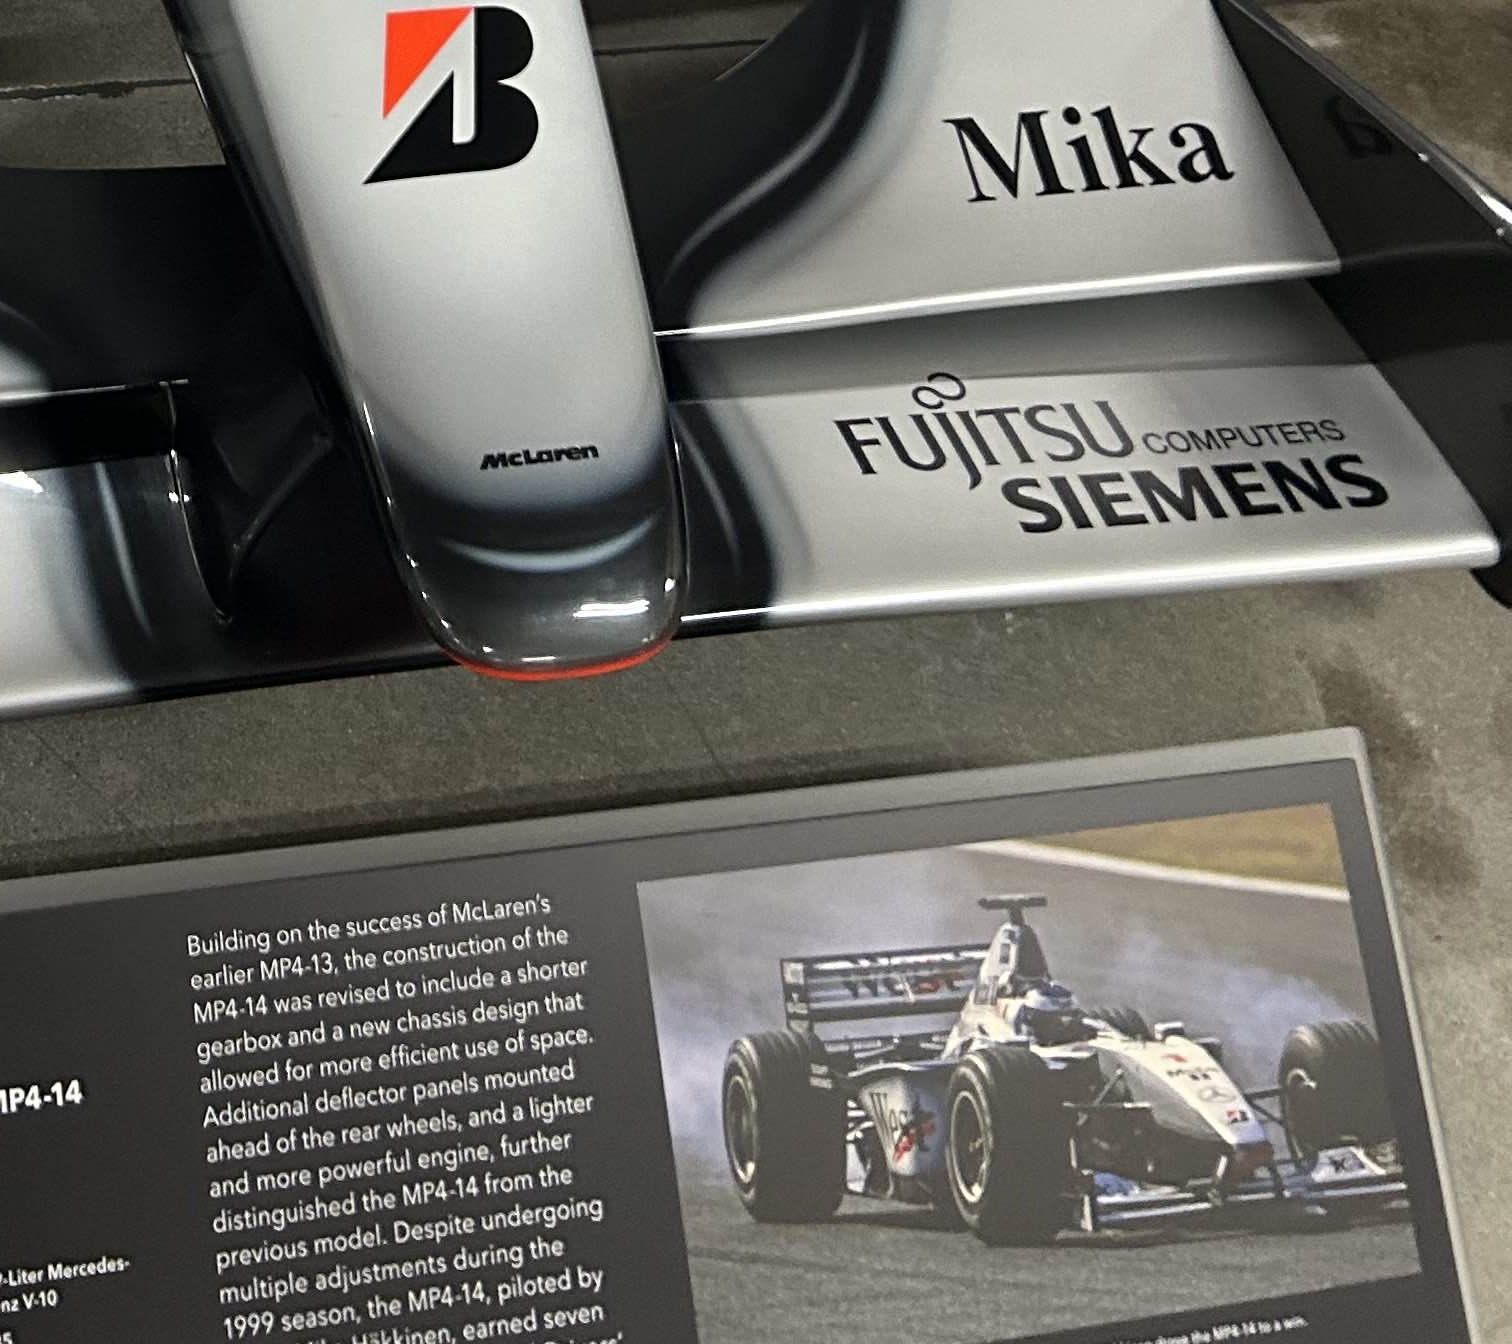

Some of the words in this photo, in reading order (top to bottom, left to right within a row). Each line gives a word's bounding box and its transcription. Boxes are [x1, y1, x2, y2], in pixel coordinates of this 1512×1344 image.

[942, 106, 1235, 202] Mika
[479, 444, 599, 471] McLaren
[833, 372, 1135, 490] FUJITSU
[1141, 419, 1347, 456] COMPUTERS
[1000, 454, 1390, 535] SIEMENS
[188, 929, 270, 956] Building
[277, 929, 302, 945] on
[308, 919, 340, 941] the
[346, 914, 422, 937] success
[428, 903, 447, 927] of
[452, 893, 551, 924] McLaren's
[191, 964, 254, 990] earlier
[260, 952, 338, 981] MP4-13,
[344, 948, 377, 970] the
[383, 934, 506, 966] construction
[512, 926, 532, 951] of
[536, 925, 568, 947] the
[194, 995, 268, 1024] MP4-14
[274, 995, 312, 1014] was
[318, 978, 390, 1007] revised
[395, 980, 416, 999] to
[422, 966, 495, 994] include
[501, 970, 512, 986] a
[517, 960, 588, 984] shorter
[197, 1030, 282, 1064] gearbox
[288, 1020, 326, 1047] and
[333, 1025, 343, 1041] a
[350, 1020, 390, 1038] new
[397, 1005, 467, 1033] chassis
[473, 998, 539, 1024] design
[544, 991, 584, 1014] that
[201, 1061, 279, 1093] allowed
[285, 1059, 313, 1081] for
[320, 1056, 372, 1077] more
[379, 1042, 460, 1070] efficient
[465, 1040, 499, 1059] use
[505, 1029, 524, 1053] of
[530, 1029, 593, 1056] space.
[203, 1092, 308, 1128] Additional
[316, 1086, 406, 1113] deflector
[413, 1072, 479, 1106] panels
[485, 1057, 575, 1090] mounted
[207, 1132, 270, 1163] ahead
[277, 1128, 297, 1153] of
[302, 1126, 335, 1149] the
[342, 1125, 380, 1144] rear
[387, 1108, 462, 1138] wheels,
[469, 1100, 506, 1127] and
[513, 1106, 524, 1121] a
[529, 1094, 593, 1124] lighter
[210, 1171, 249, 1197] and
[257, 1170, 311, 1191] more
[319, 1148, 411, 1188] powerful
[418, 1143, 494, 1171] engine,
[500, 1131, 572, 1157] further
[212, 1188, 356, 1236] distinguished
[362, 1189, 396, 1212] the
[403, 1176, 479, 1206] MP4-14
[484, 1172, 533, 1194] from
[539, 1164, 572, 1187] the
[217, 1240, 308, 1275] previous
[314, 1224, 387, 1254] model.
[394, 1215, 475, 1243] Despite
[481, 1198, 603, 1231] undergoing
[220, 1272, 308, 1304] multiple
[315, 1254, 448, 1293] adjustments
[453, 1245, 523, 1270] during
[529, 1236, 563, 1259] the
[22, 1289, 58, 1309] V-10
[224, 1311, 274, 1339] 1999
[281, 1306, 361, 1332] season,
[367, 1295, 401, 1318] the
[408, 1281, 490, 1312] MP4-14,
[498, 1267, 571, 1306] piloted
[577, 1266, 603, 1292] by
[463, 1308, 537, 1340] earned
[544, 1306, 603, 1329] seven
